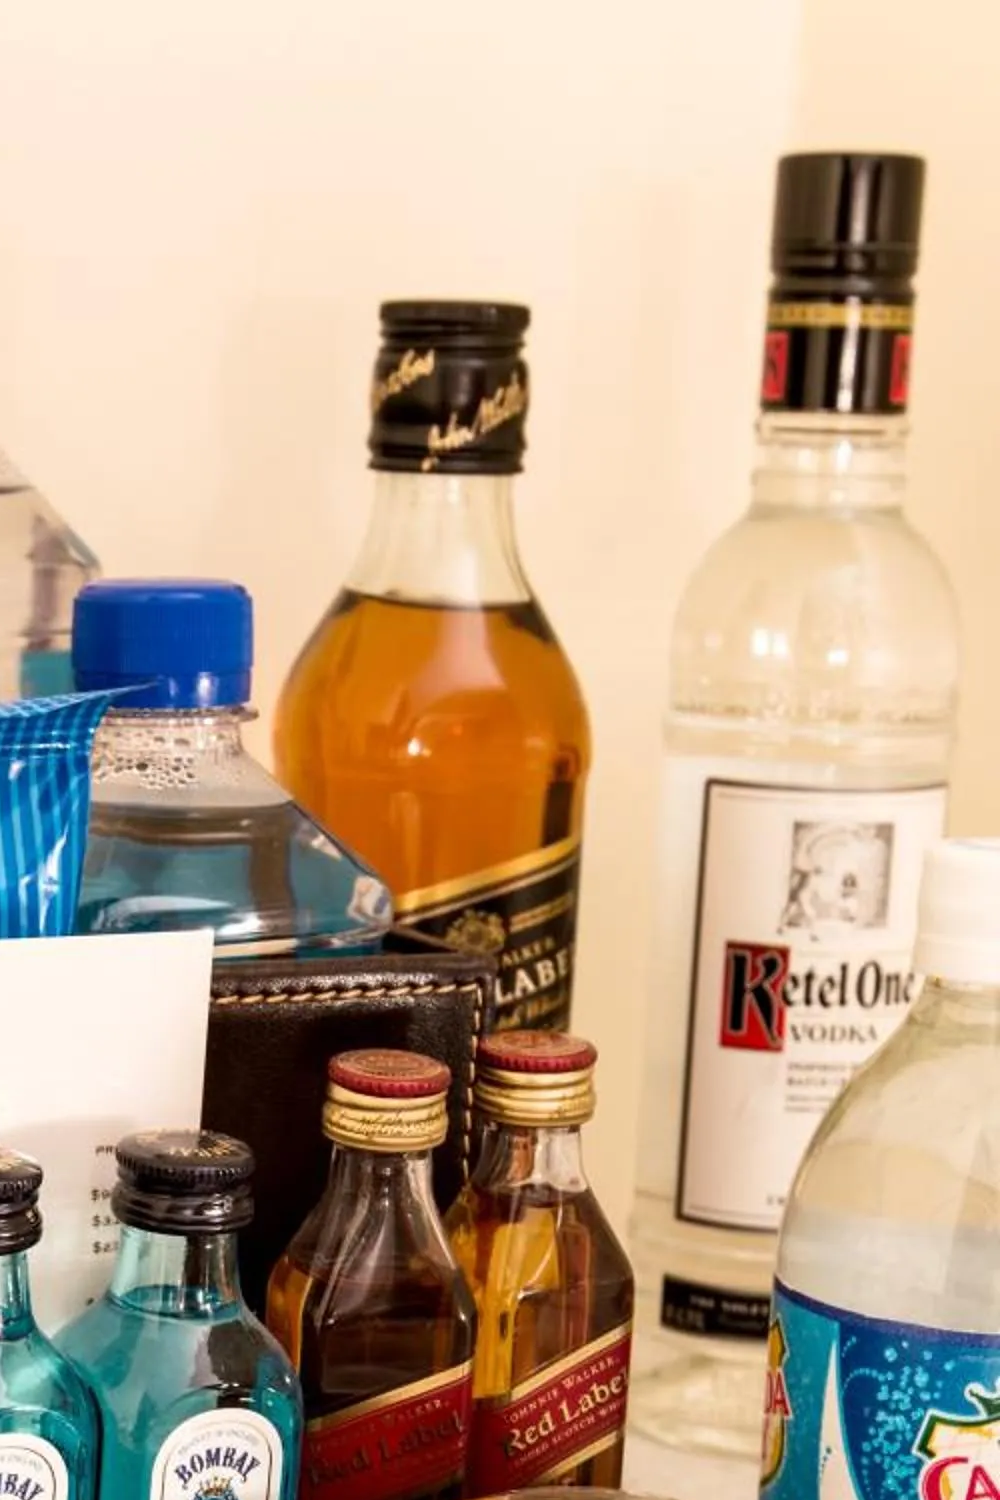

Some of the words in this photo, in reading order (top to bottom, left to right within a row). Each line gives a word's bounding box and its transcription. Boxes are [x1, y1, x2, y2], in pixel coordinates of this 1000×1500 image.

[494, 948, 571, 1005] LABE
[727, 950, 848, 1048] Ketel
[856, 959, 916, 1009] One
[789, 1023, 878, 1045] VODKA
[504, 1409, 556, 1457] Red
[174, 1447, 262, 1490] BOMBAY
